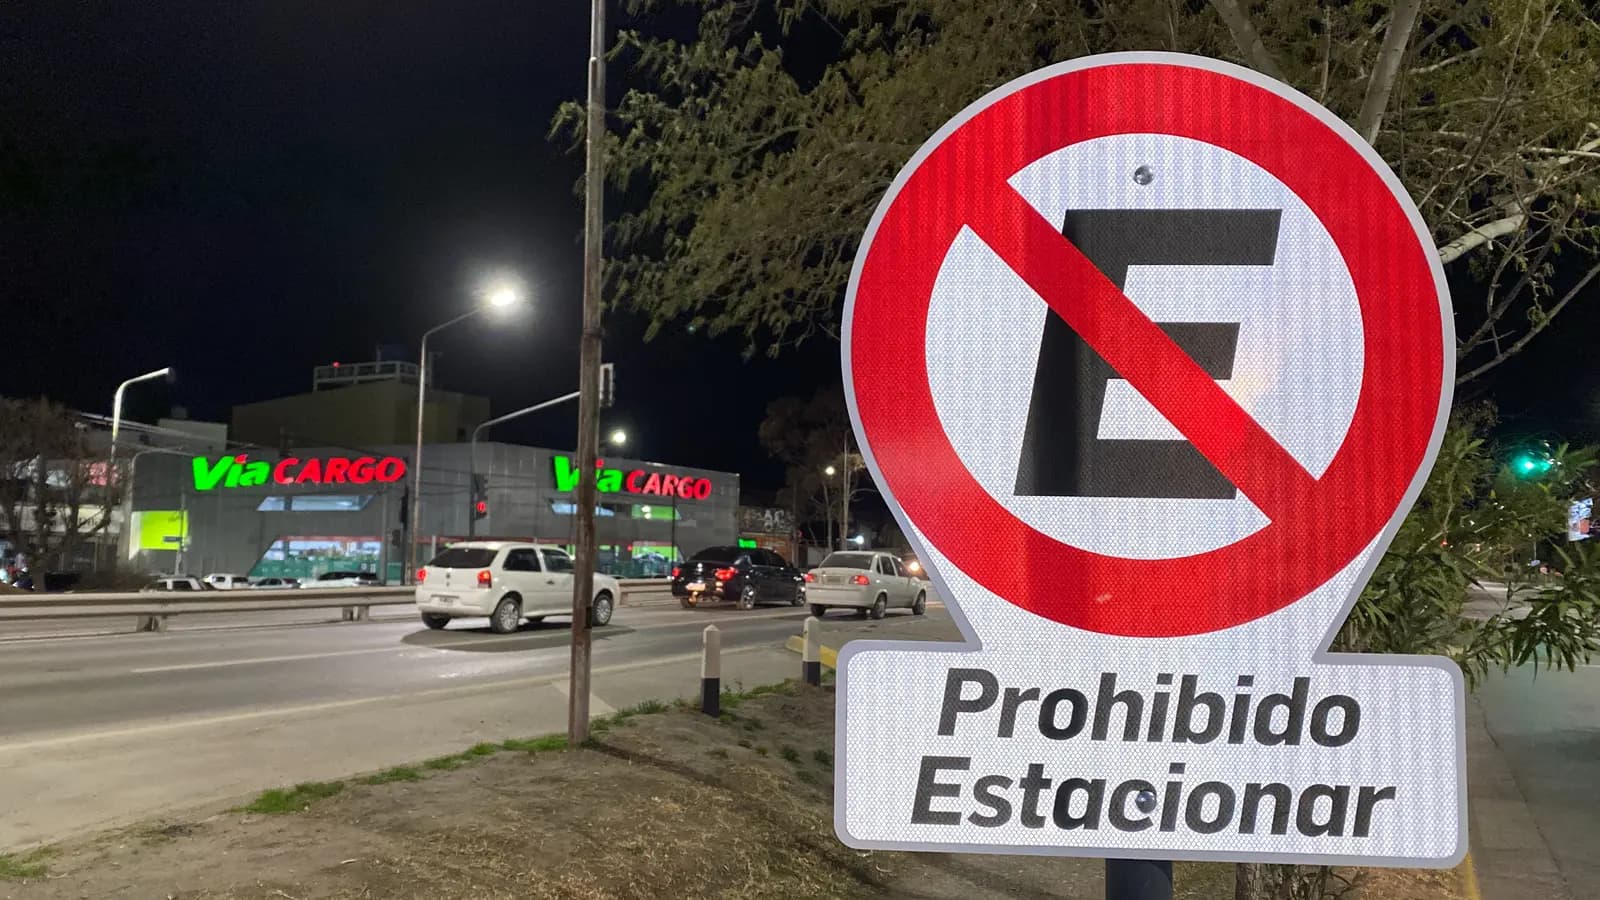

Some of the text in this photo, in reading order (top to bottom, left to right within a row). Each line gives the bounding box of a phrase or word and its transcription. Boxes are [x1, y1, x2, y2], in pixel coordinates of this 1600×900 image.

[1015, 209, 1281, 498] E
[191, 455, 406, 490] Via CARGO
[625, 470, 712, 500] CARGO
[938, 668, 1361, 748] Prohibido
[911, 756, 1395, 838] Estacionar
